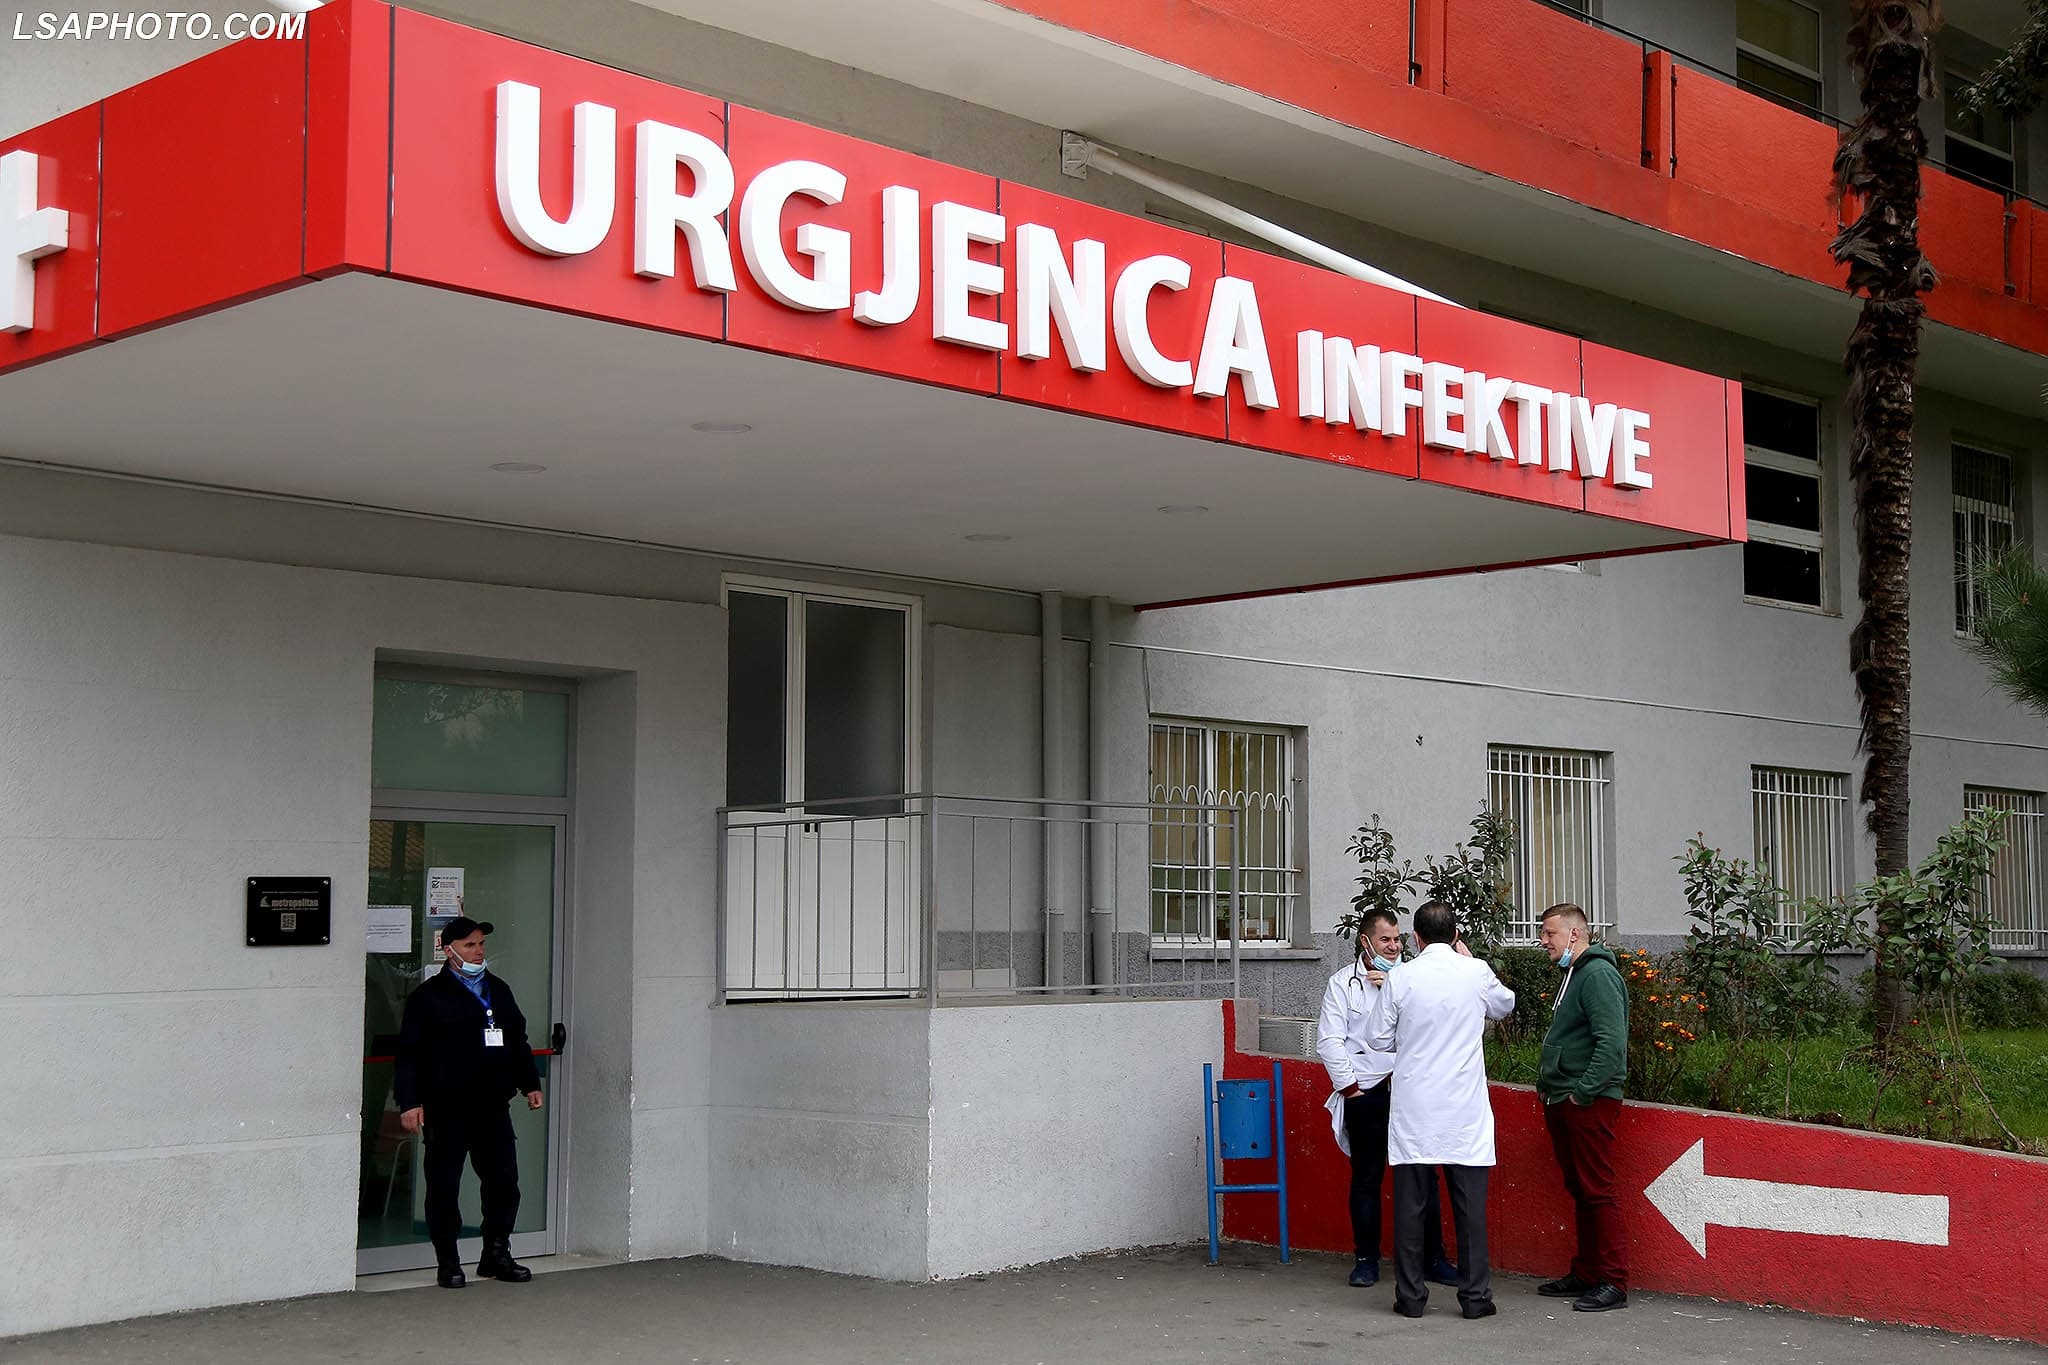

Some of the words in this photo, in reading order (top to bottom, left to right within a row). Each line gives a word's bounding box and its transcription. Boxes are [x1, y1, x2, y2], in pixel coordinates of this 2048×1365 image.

[495, 80, 1279, 410] URGJENCA
[1297, 329, 1653, 490] INFEKTIVE
[271, 898, 319, 908] metropolitan
